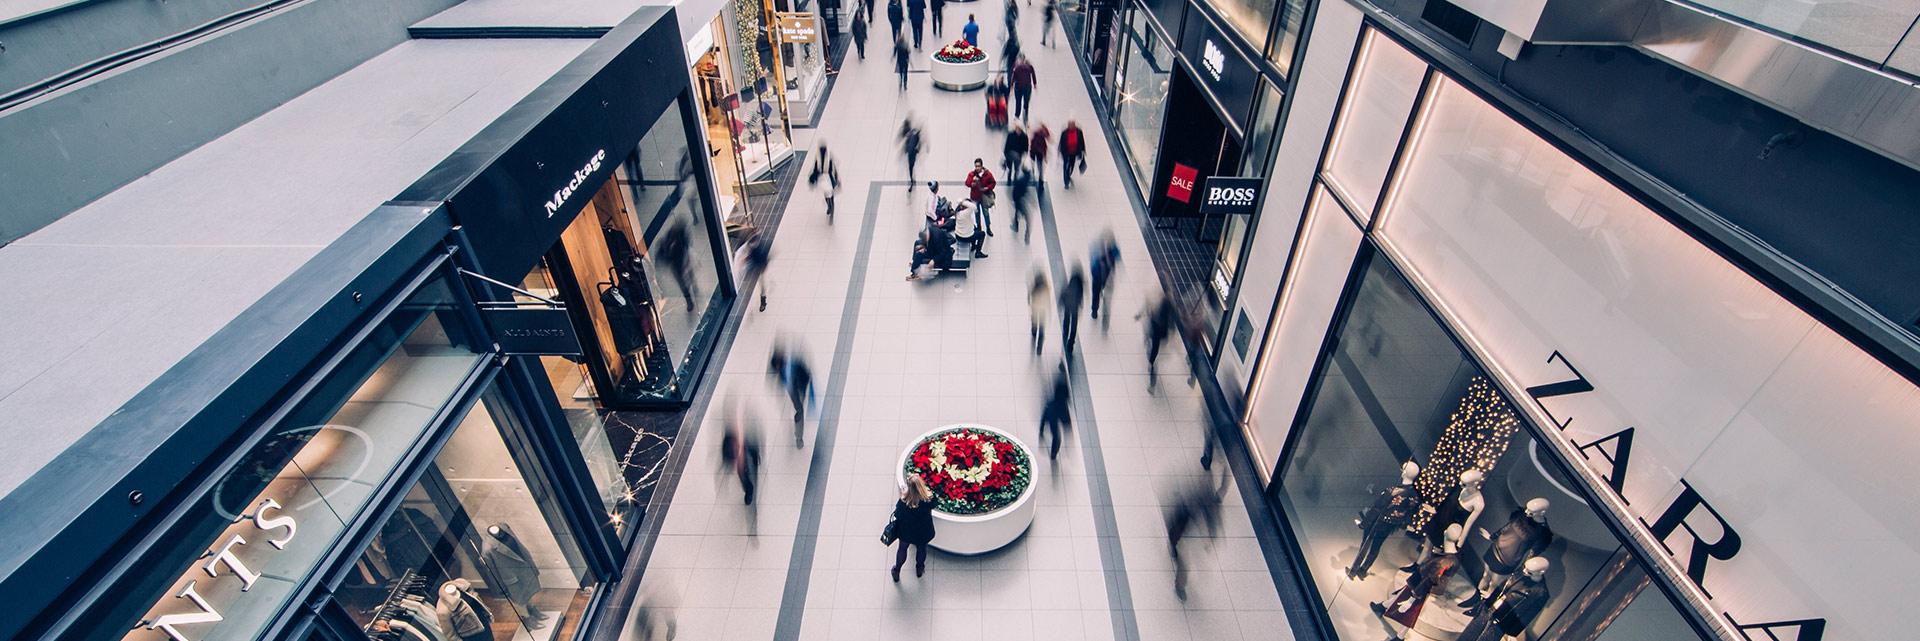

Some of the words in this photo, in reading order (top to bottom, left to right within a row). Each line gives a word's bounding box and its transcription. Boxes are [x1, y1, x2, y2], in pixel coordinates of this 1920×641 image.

[544, 149, 605, 218] Mackage
[1171, 176, 1193, 191] SALE
[1208, 187, 1255, 201] BOSS
[504, 329, 565, 337] ALLSAINTS
